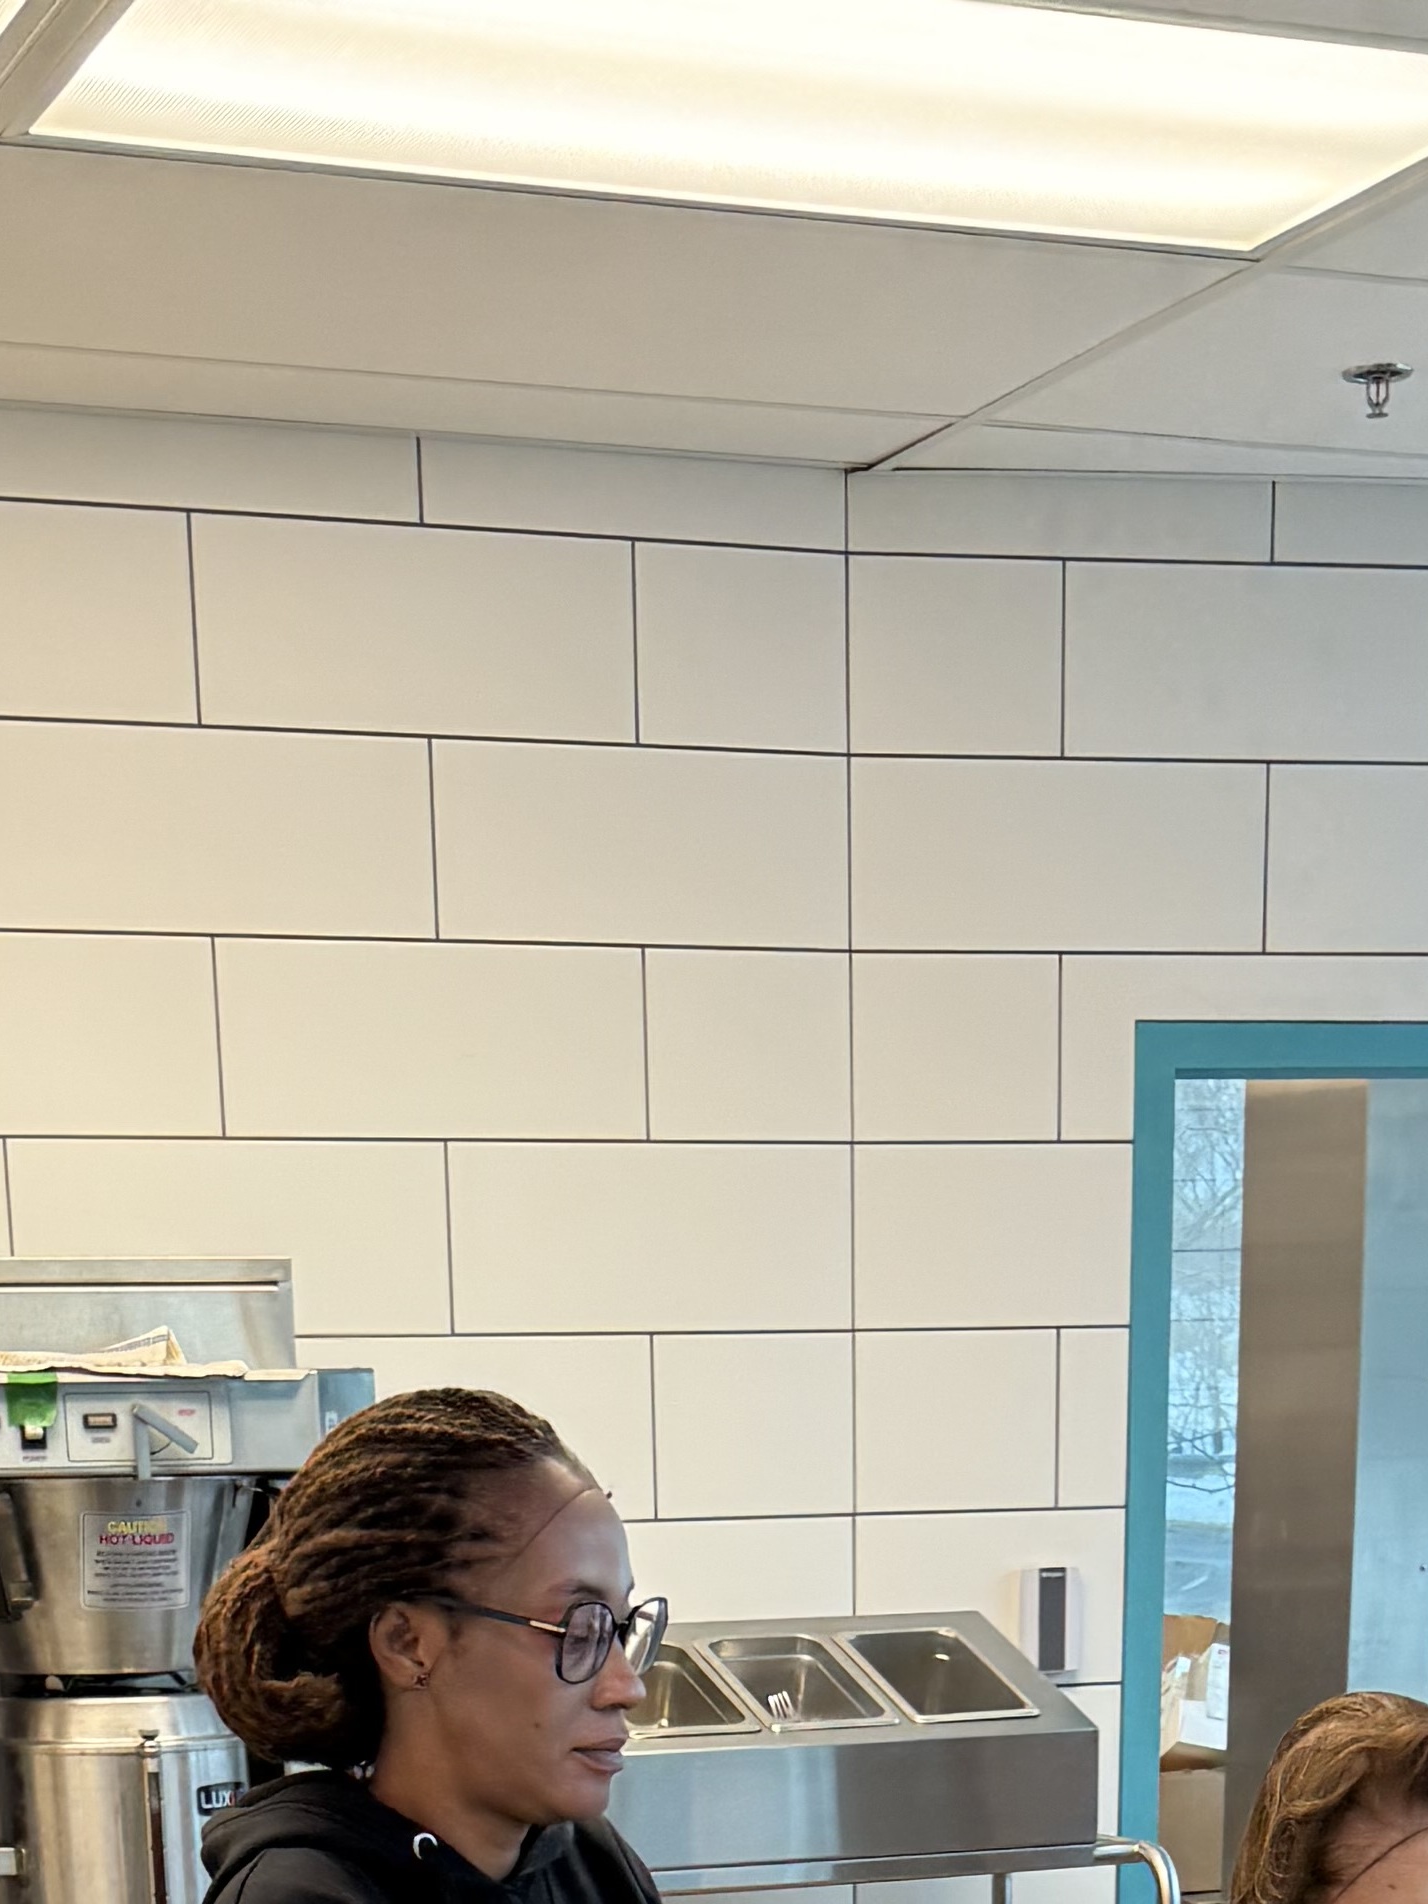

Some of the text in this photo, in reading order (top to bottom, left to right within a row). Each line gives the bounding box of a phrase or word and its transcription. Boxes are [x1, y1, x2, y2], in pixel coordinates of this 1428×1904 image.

[99, 1532, 175, 1546] HOT LIQUID
[199, 1789, 237, 1810] LUX
